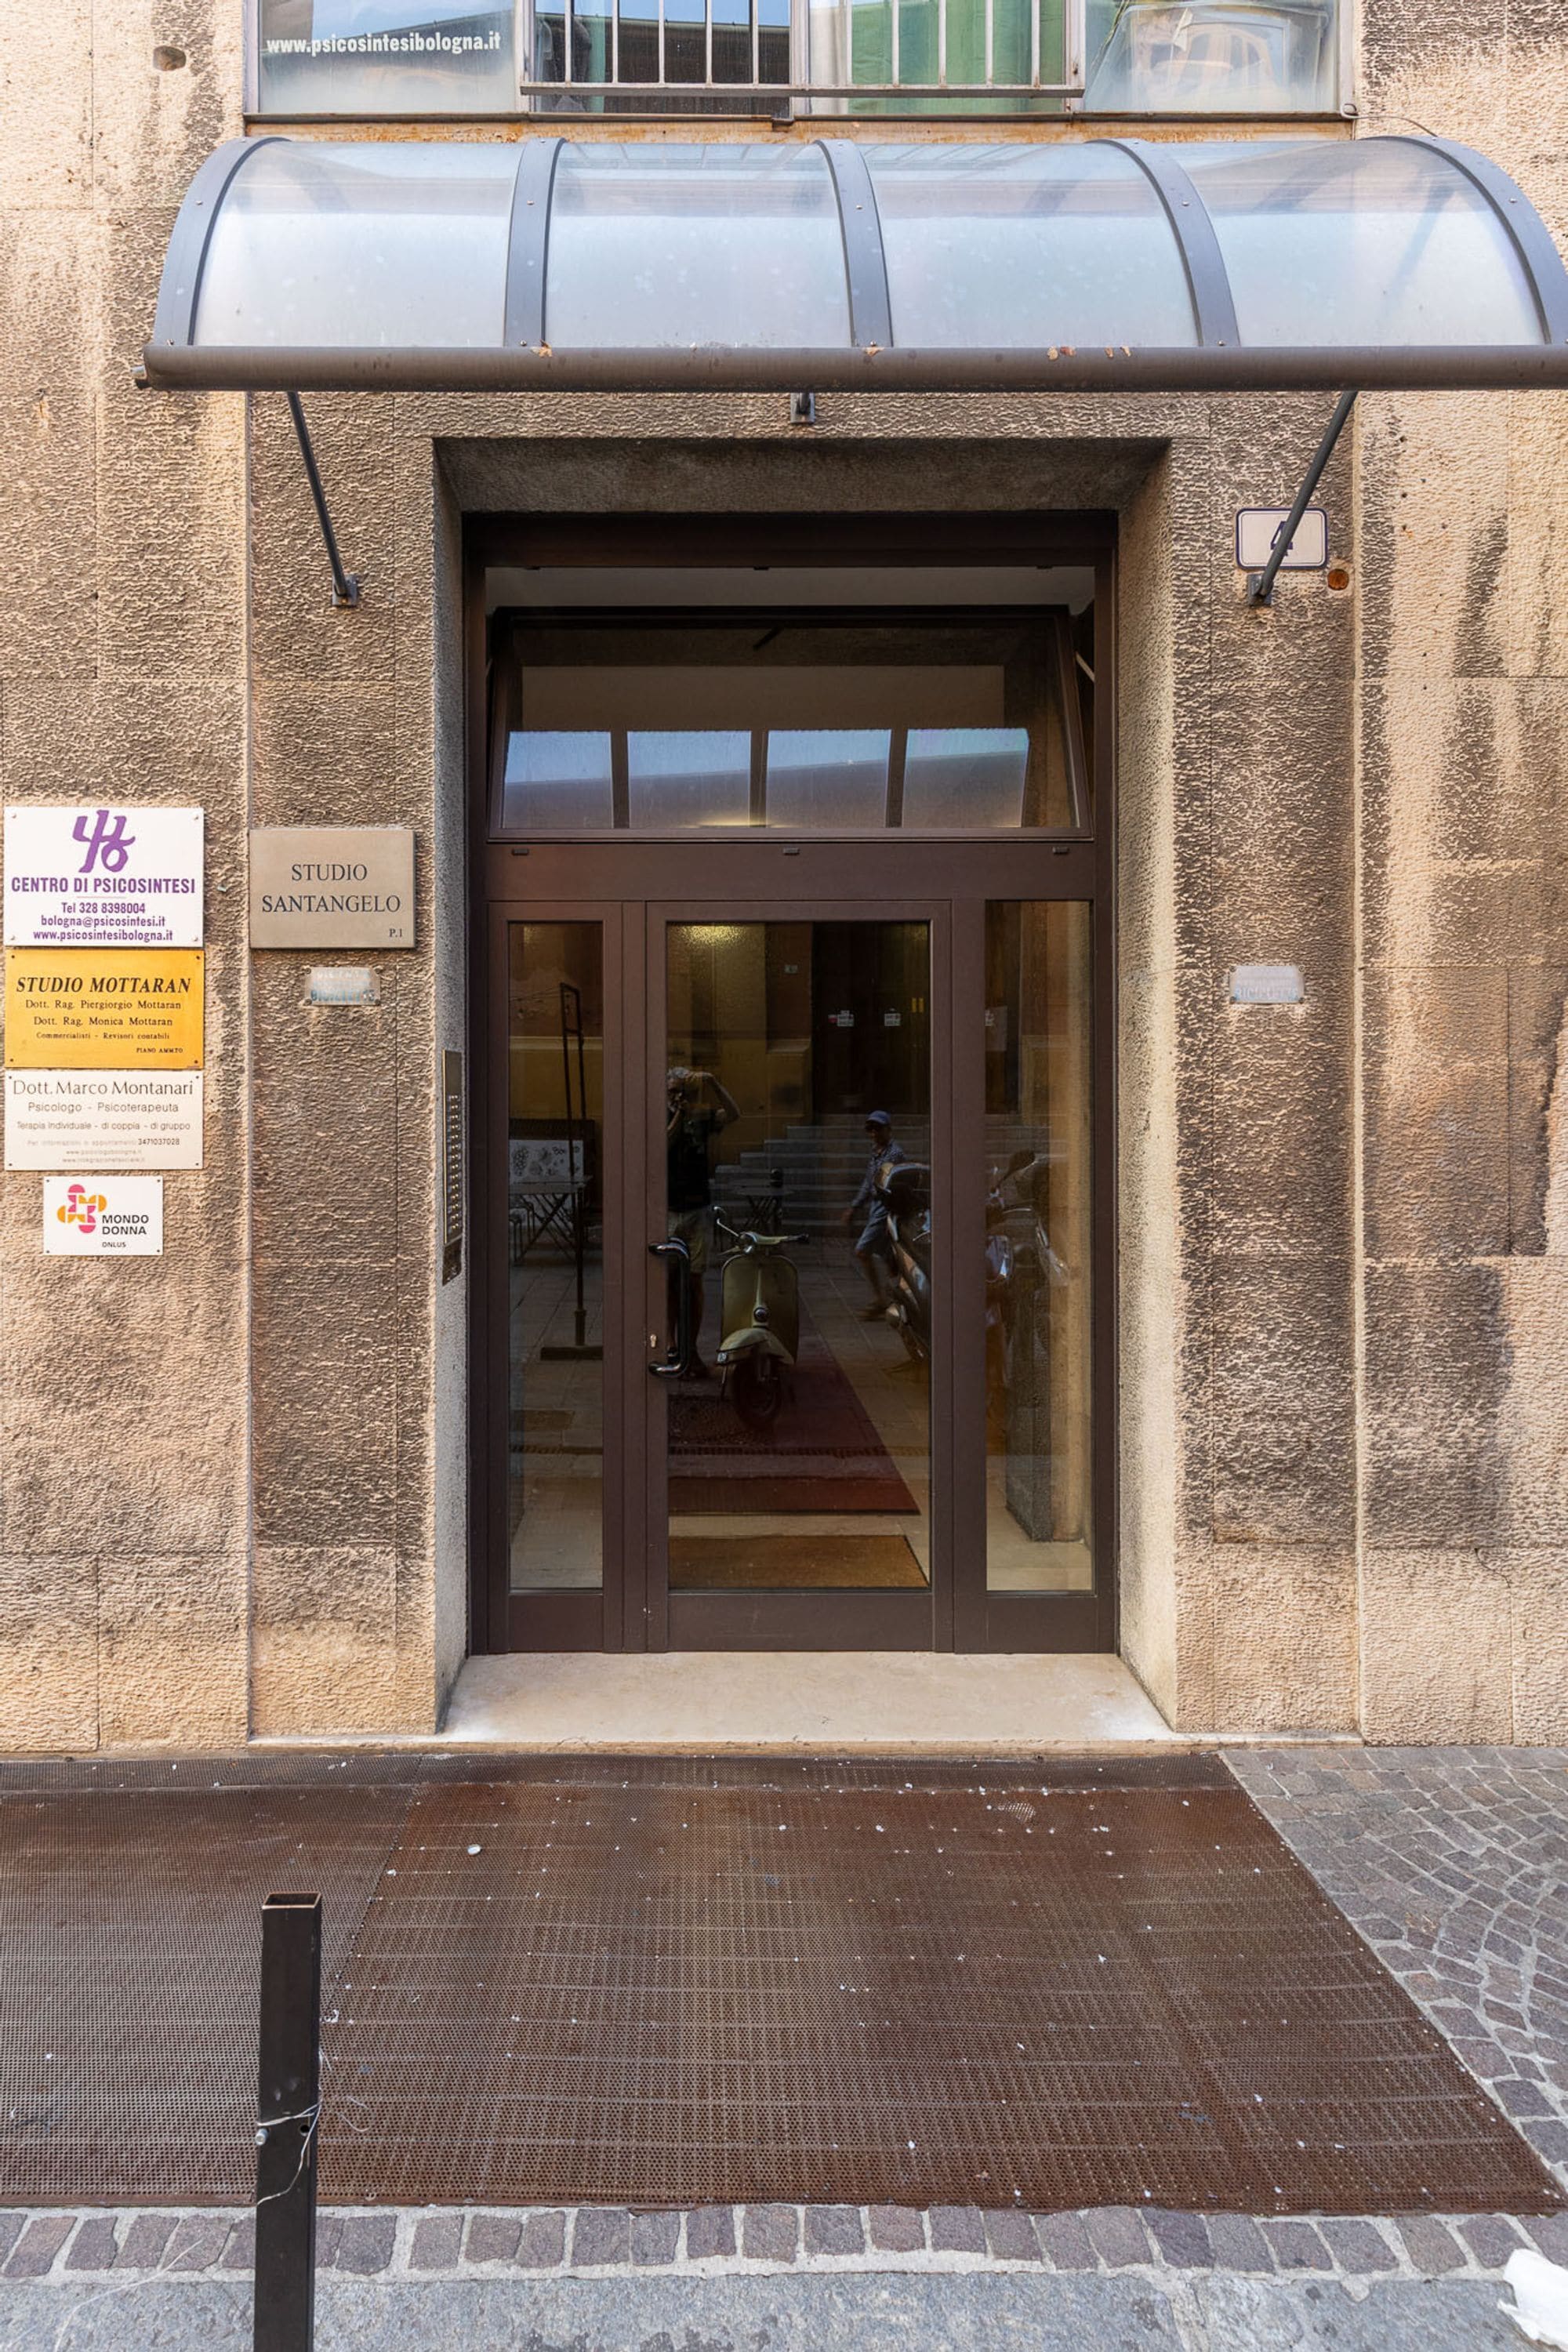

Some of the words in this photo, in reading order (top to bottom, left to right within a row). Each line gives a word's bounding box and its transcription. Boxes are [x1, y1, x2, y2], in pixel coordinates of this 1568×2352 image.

[267, 31, 501, 57] www.psicosintesibologna.it
[292, 864, 367, 881] STUDIO
[12, 877, 67, 892] CENTRO
[74, 878, 87, 892] DI
[94, 878, 194, 893] PSICOSINTESI
[62, 902, 75, 913] Tel
[79, 902, 97, 913] 328
[102, 903, 145, 913] 8398004
[263, 895, 401, 912] SANTANGELO
[42, 915, 165, 928] bologna@psicosintesi.it
[33, 929, 172, 942] www.psicosintesibologna.it
[390, 928, 402, 937] P.1
[16, 978, 82, 992] STUDIO
[89, 978, 191, 993] MOTTARAN
[26, 1000, 49, 1008] Dott.
[81, 1000, 132, 1011] Piergiorgio
[138, 1000, 180, 1009] Mottaran
[34, 1016, 57, 1025] Dott.
[64, 1017, 83, 1027] Rag.
[14, 1080, 53, 1094] Dott.
[56, 1081, 107, 1094] Marco
[112, 1080, 192, 1094] Montanari
[28, 1102, 82, 1114] Psicologo
[98, 1102, 179, 1113] Psicoterapeuta
[17, 1121, 45, 1131] Terapia
[112, 1122, 140, 1131] coppia
[160, 1122, 191, 1132] gruppo
[103, 1215, 149, 1224] MONDO
[103, 1226, 147, 1235] DONNA
